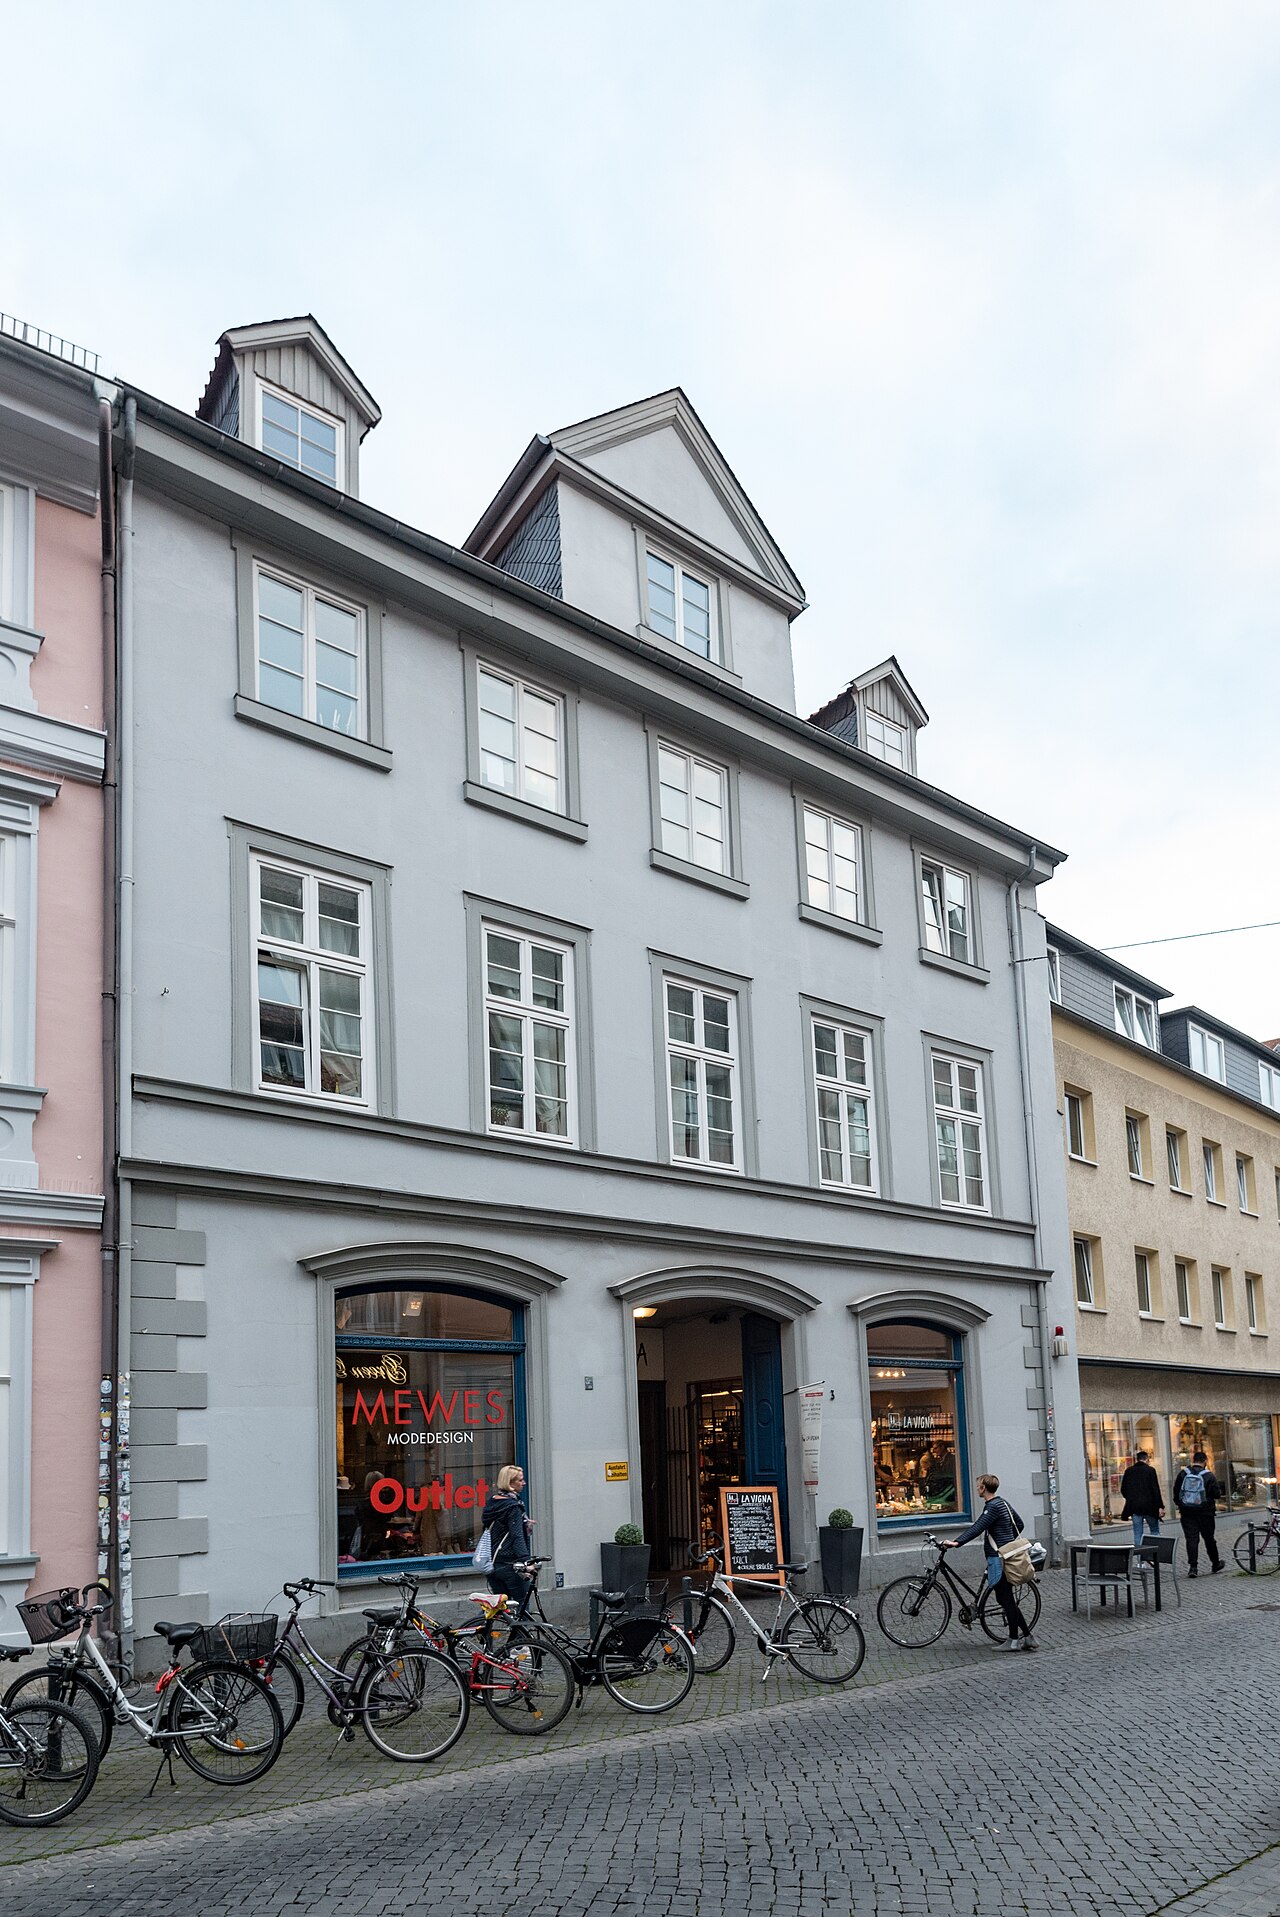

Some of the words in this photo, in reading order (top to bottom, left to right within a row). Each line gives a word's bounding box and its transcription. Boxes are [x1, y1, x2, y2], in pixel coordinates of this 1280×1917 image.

[352, 1388, 505, 1425] MEWES
[903, 1416, 912, 1429] LA
[913, 1415, 935, 1429] VIGNA
[387, 1431, 474, 1445] MODEDESIGN
[370, 1473, 489, 1514] Outlet
[741, 1495, 749, 1503] LA
[750, 1494, 772, 1503] VIGNA
